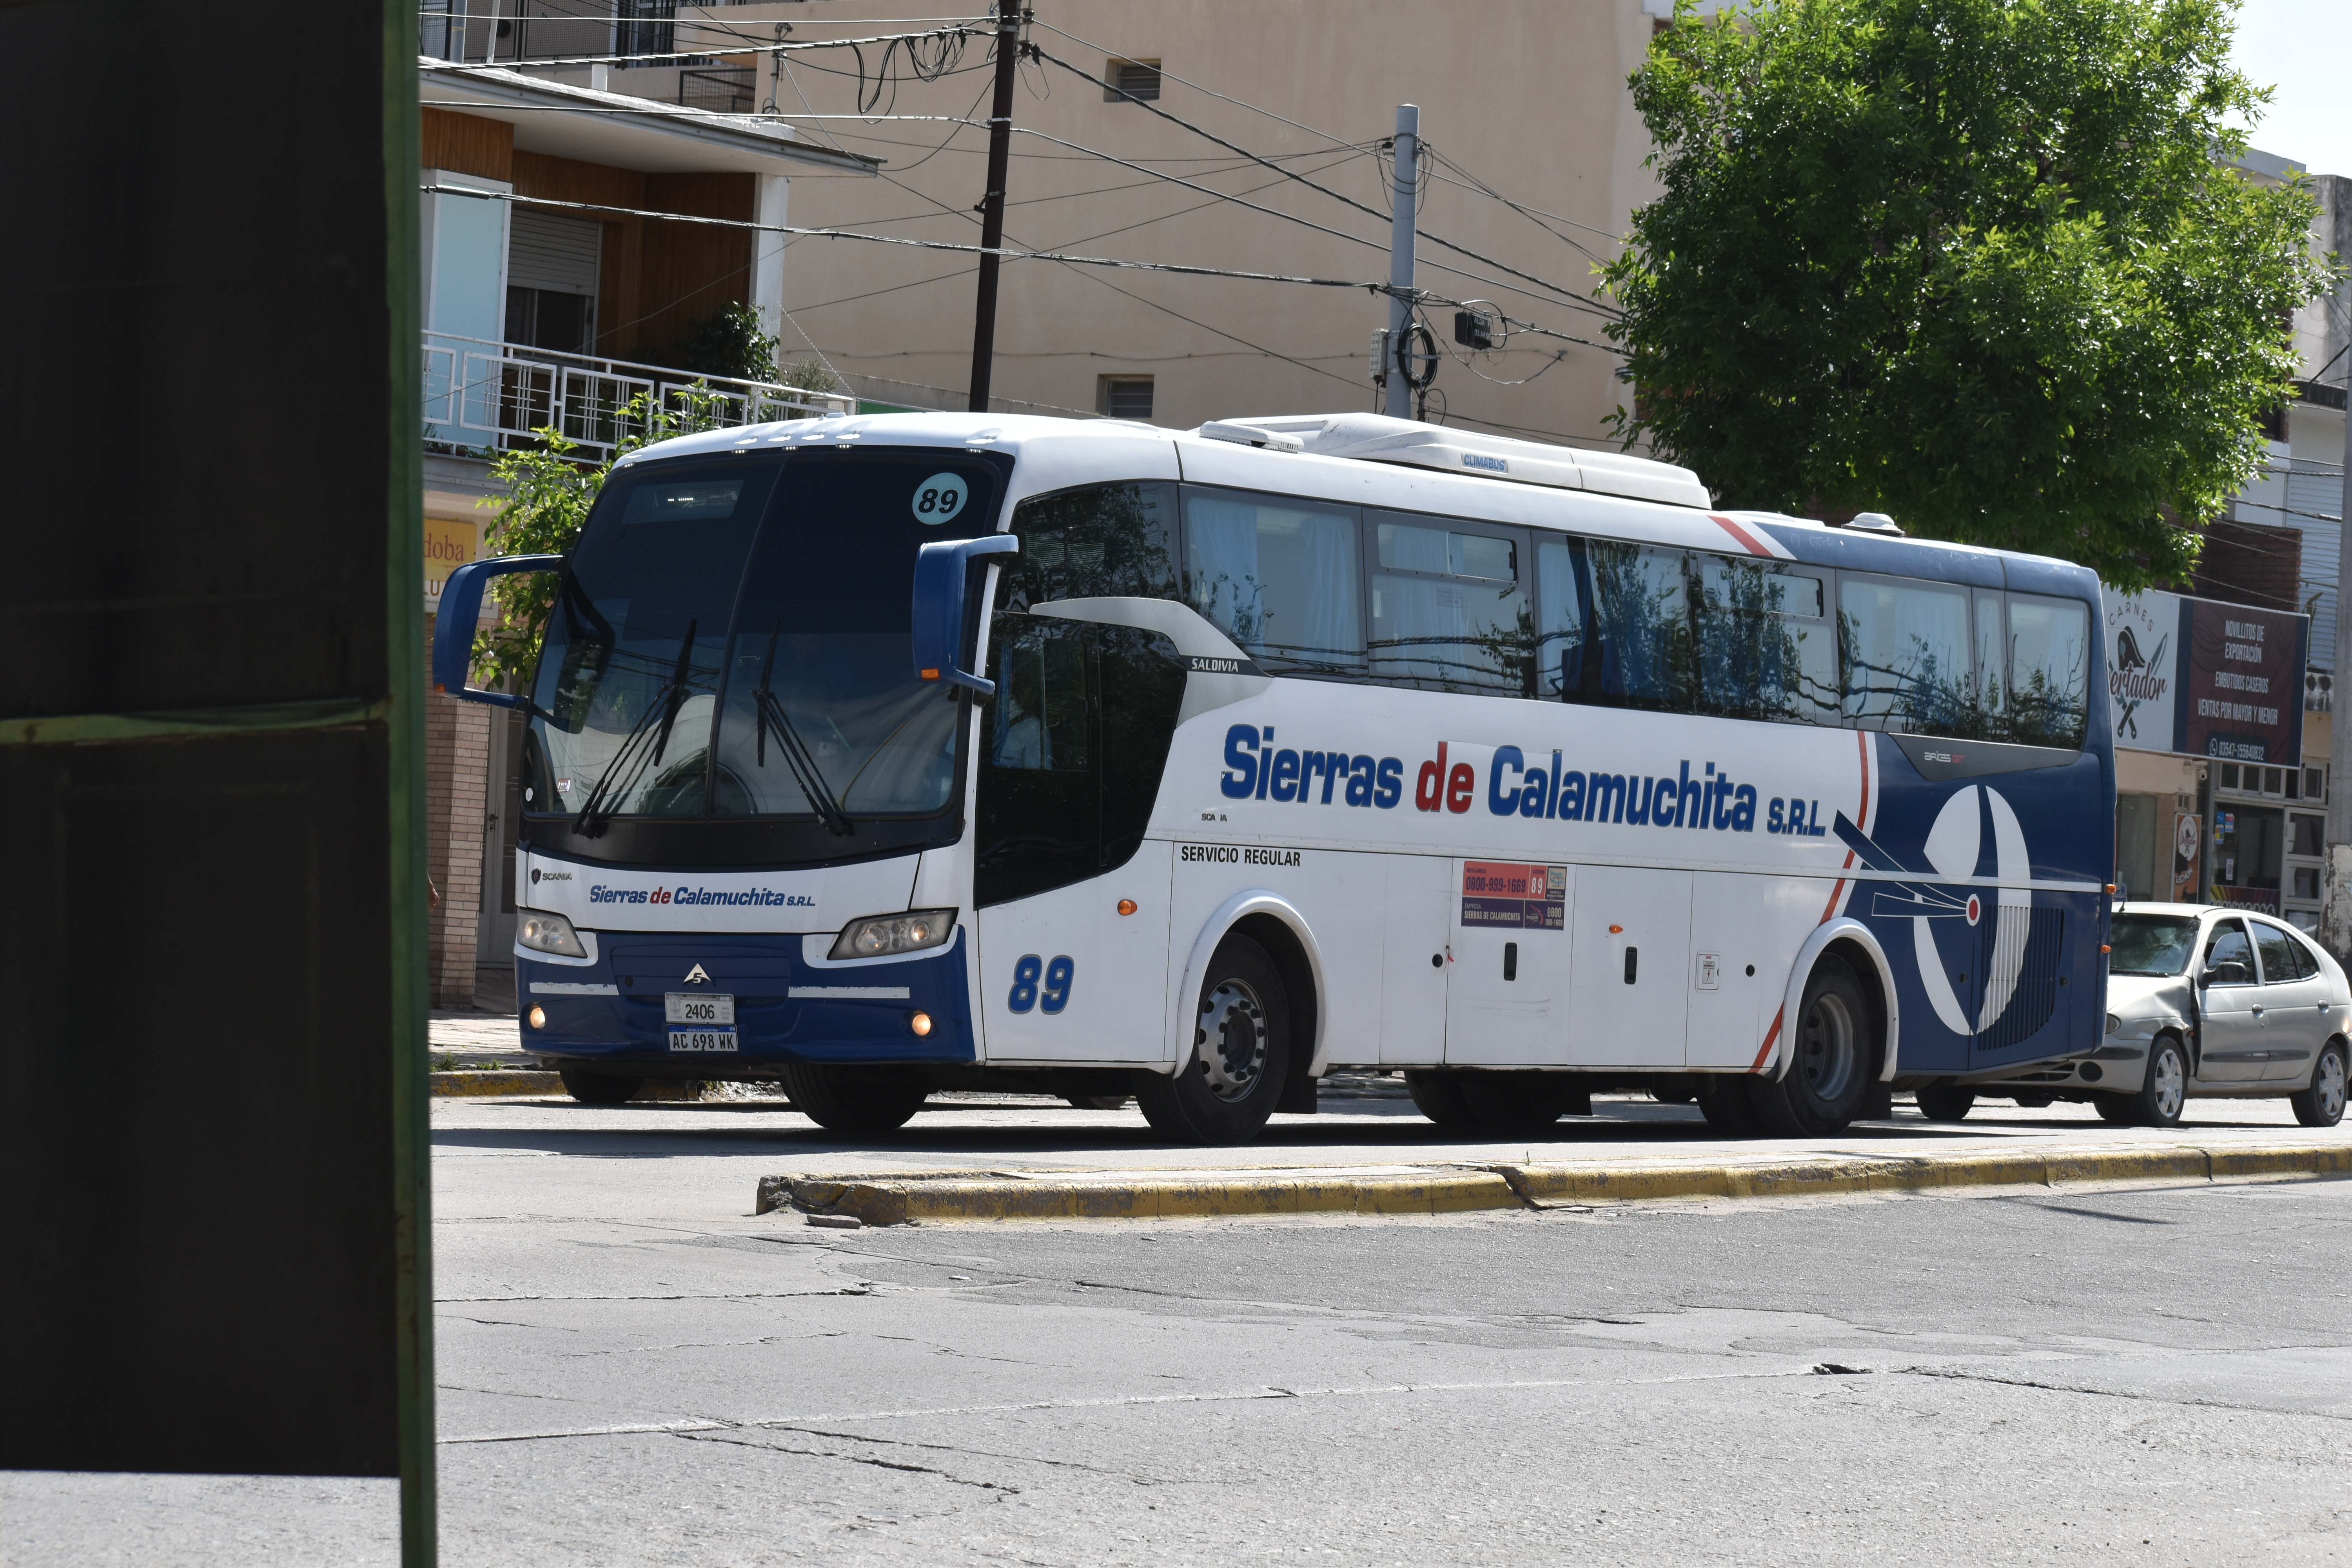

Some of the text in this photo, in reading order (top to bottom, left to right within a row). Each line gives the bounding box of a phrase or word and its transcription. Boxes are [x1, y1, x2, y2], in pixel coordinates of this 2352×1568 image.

[1464, 455, 1504, 471] CLIMABUS
[918, 488, 958, 514] 89
[2109, 602, 2154, 632] CARNES
[2225, 620, 2265, 642] NOVILLITOS DE
[2225, 642, 2262, 663] EXPORTACIÓN
[1192, 658, 1239, 673] SALDIVIA
[2109, 661, 2167, 701] ertador
[2215, 671, 2269, 694] EMBUTIDOS CASEROS
[2198, 698, 2278, 725] VENTAS POR MAYOR Y MENOR
[2219, 741, 2265, 761] 03547-155640832
[1220, 723, 1826, 837] Sierras de Calamuchita S.R.L.
[1181, 846, 1301, 867] SERVICIO REGULAR
[1466, 876, 1526, 893] 0800-999-1669
[1531, 877, 1543, 894] 89
[590, 885, 816, 907] Sierras de Calamuchita S.R.L.
[1465, 910, 1482, 919] SIERRAS
[1490, 911, 1521, 921] CALAMUCHITA
[1545, 918, 1563, 927] 999-1669
[1547, 907, 1562, 918] 0800
[1007, 953, 1075, 1015] 89
[686, 1004, 715, 1019] 2406
[673, 1034, 734, 1049] AC 698 WK
